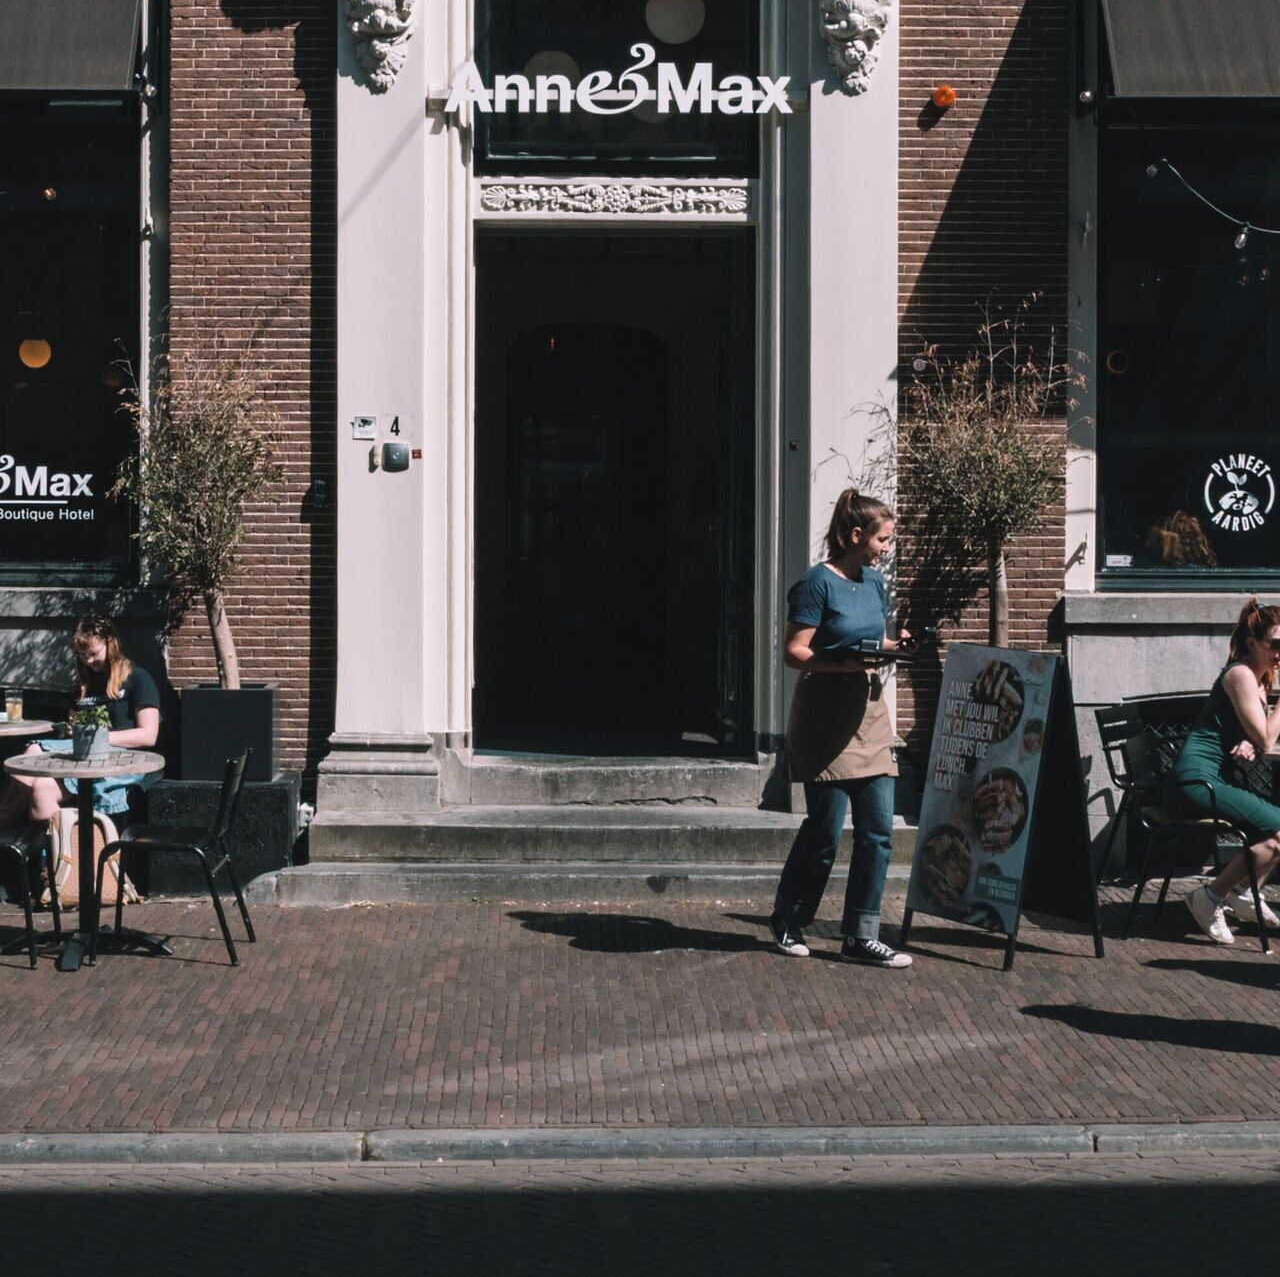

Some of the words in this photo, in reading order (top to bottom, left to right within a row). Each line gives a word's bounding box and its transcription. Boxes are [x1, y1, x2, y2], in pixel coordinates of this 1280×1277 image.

[390, 416, 401, 436] 4
[1211, 453, 1271, 477] PLANEET
[59, 509, 94, 520] Hotel
[1211, 510, 1265, 531] AARDIG
[948, 681, 974, 700] ANNE,
[945, 699, 964, 717] MET
[966, 702, 982, 720] JOU
[983, 704, 999, 722] WIL
[942, 717, 952, 733] IK
[953, 719, 993, 741] CLUBBEN
[940, 736, 975, 756] TIJDENS
[975, 742, 988, 759] DE
[934, 772, 953, 791] MAX
